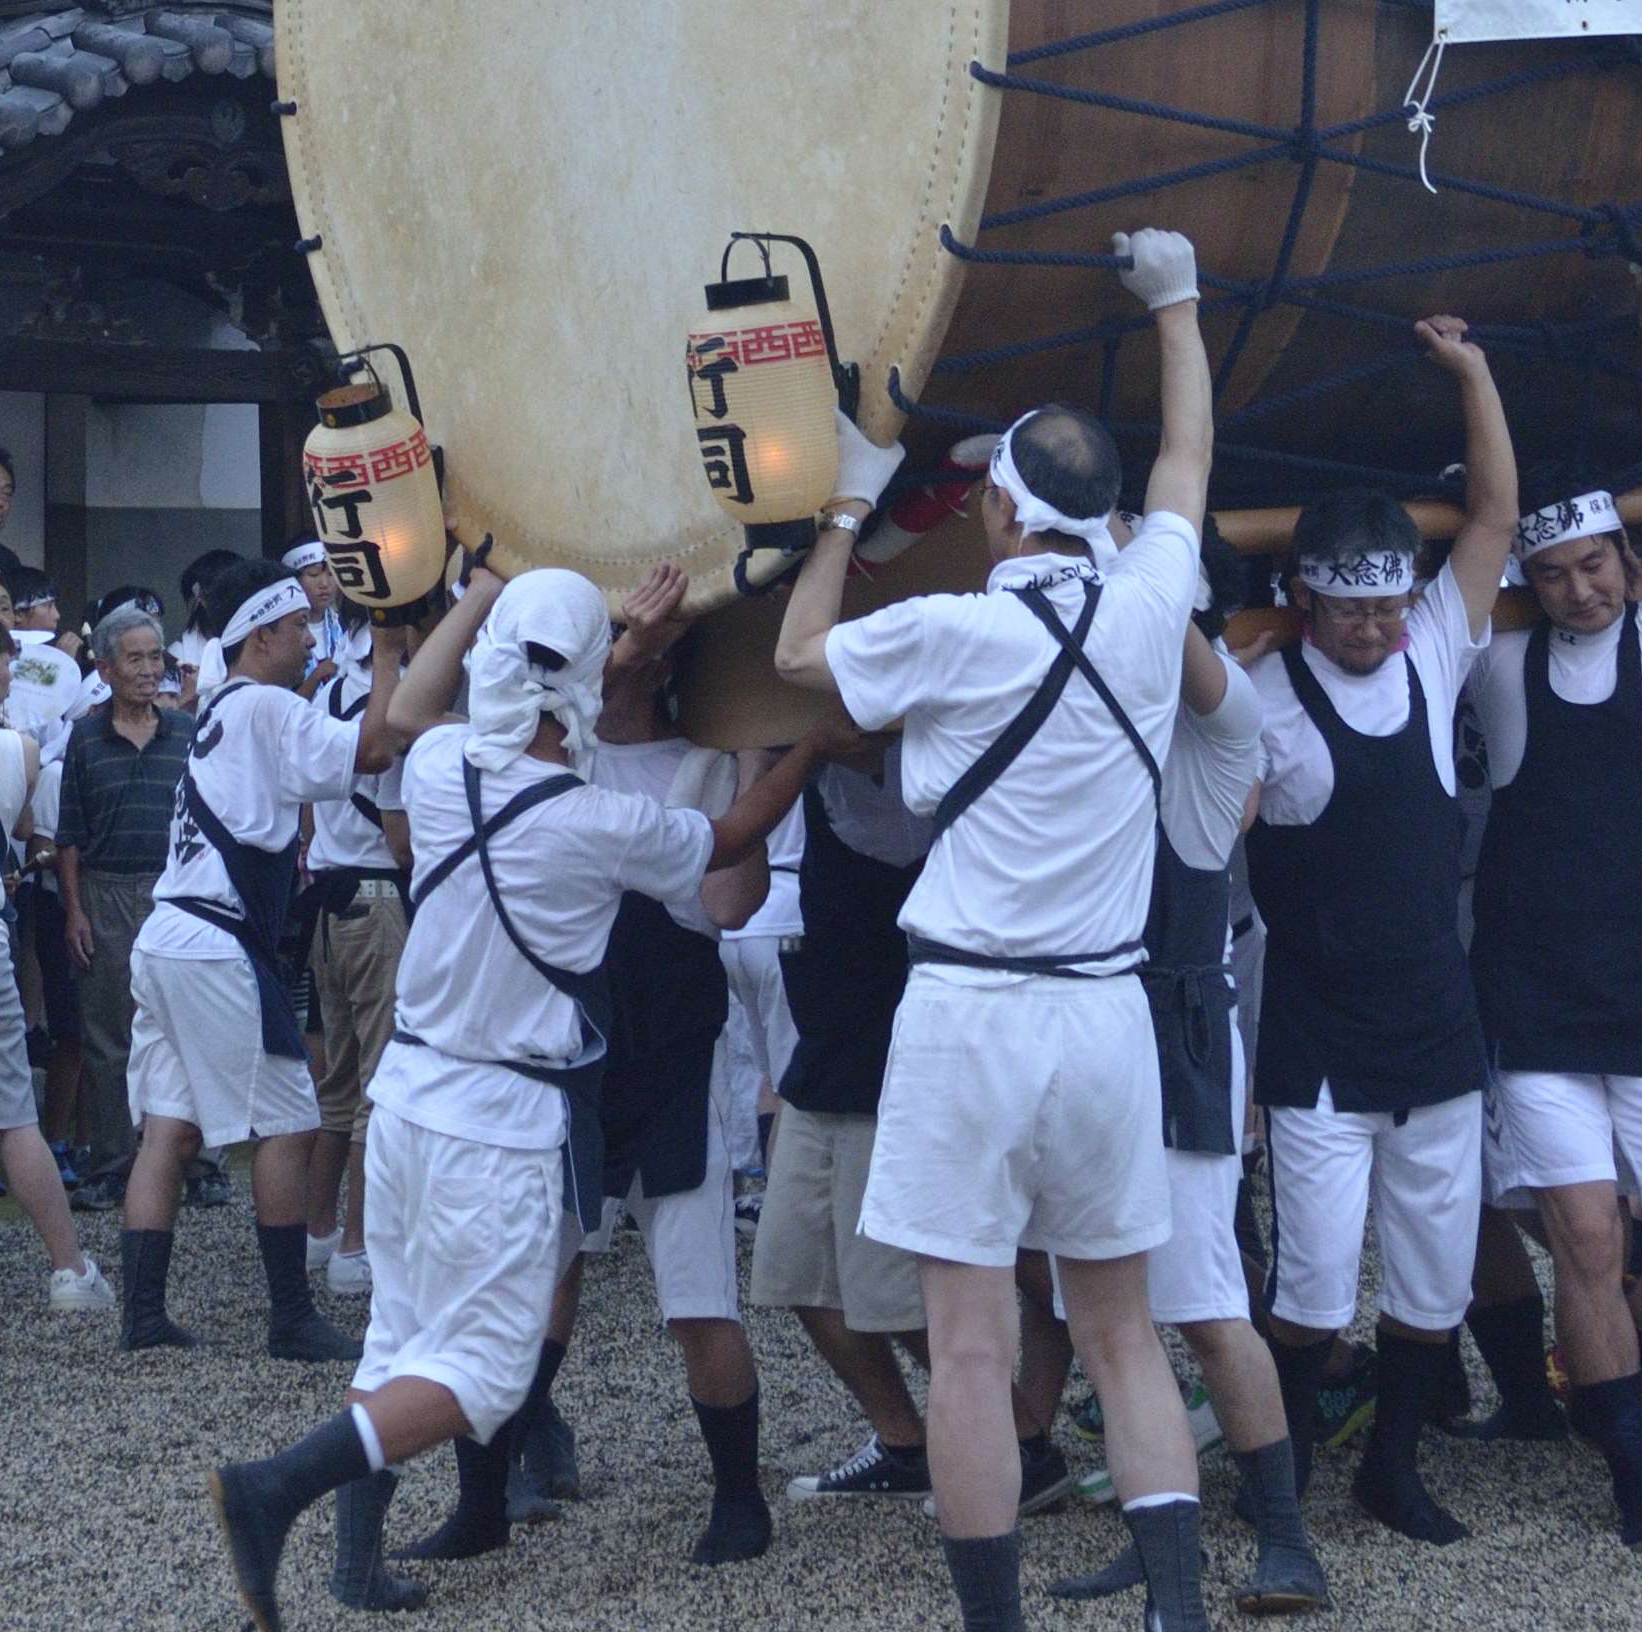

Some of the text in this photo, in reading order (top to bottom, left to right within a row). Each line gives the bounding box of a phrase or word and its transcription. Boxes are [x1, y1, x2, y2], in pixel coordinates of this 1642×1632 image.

[307, 463, 392, 599] 行司
[1327, 552, 1404, 586] 大念佛
